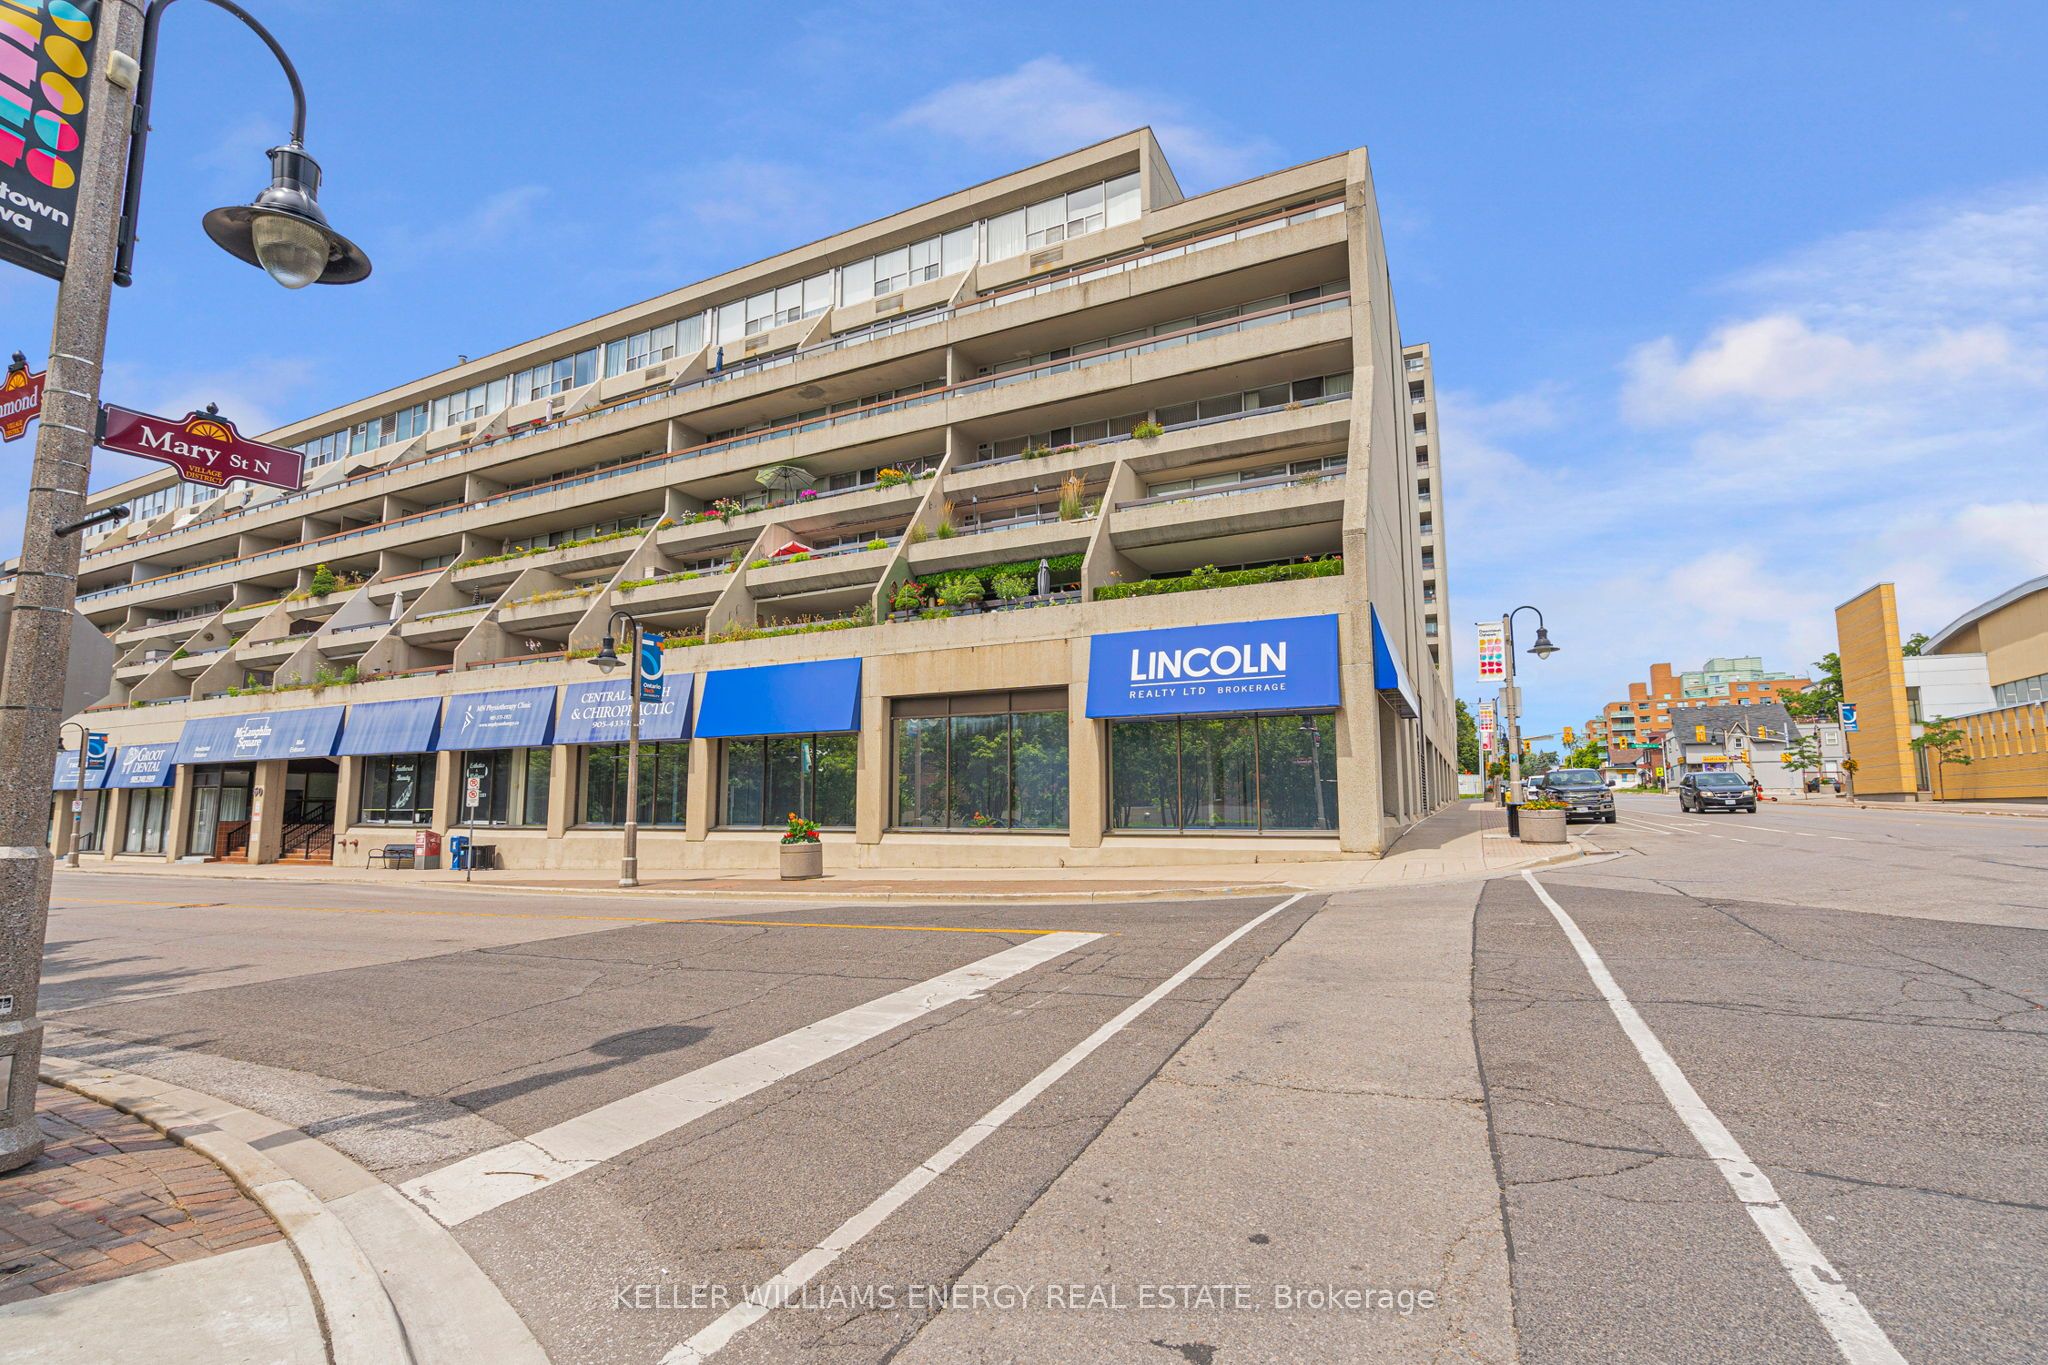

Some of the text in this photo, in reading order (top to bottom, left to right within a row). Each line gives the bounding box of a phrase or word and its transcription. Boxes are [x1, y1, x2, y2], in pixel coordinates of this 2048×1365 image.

[138, 425, 272, 475] Mary St N
[188, 464, 223, 478] VILLAGE
[185, 471, 223, 484] DISTRICT
[1130, 641, 1287, 681] LINCOLN
[643, 682, 662, 690] Ontario
[1129, 682, 1287, 699] REALTY LTD BROKERAGE
[581, 690, 627, 704] CENTRAL
[518, 701, 532, 709] Clinic
[571, 708, 580, 720] &
[592, 719, 645, 729] 905-433-10
[234, 726, 272, 738] McLaughlin
[238, 738, 262, 749] Square
[138, 748, 166, 761] GROOT
[132, 762, 161, 773] DENTAL
